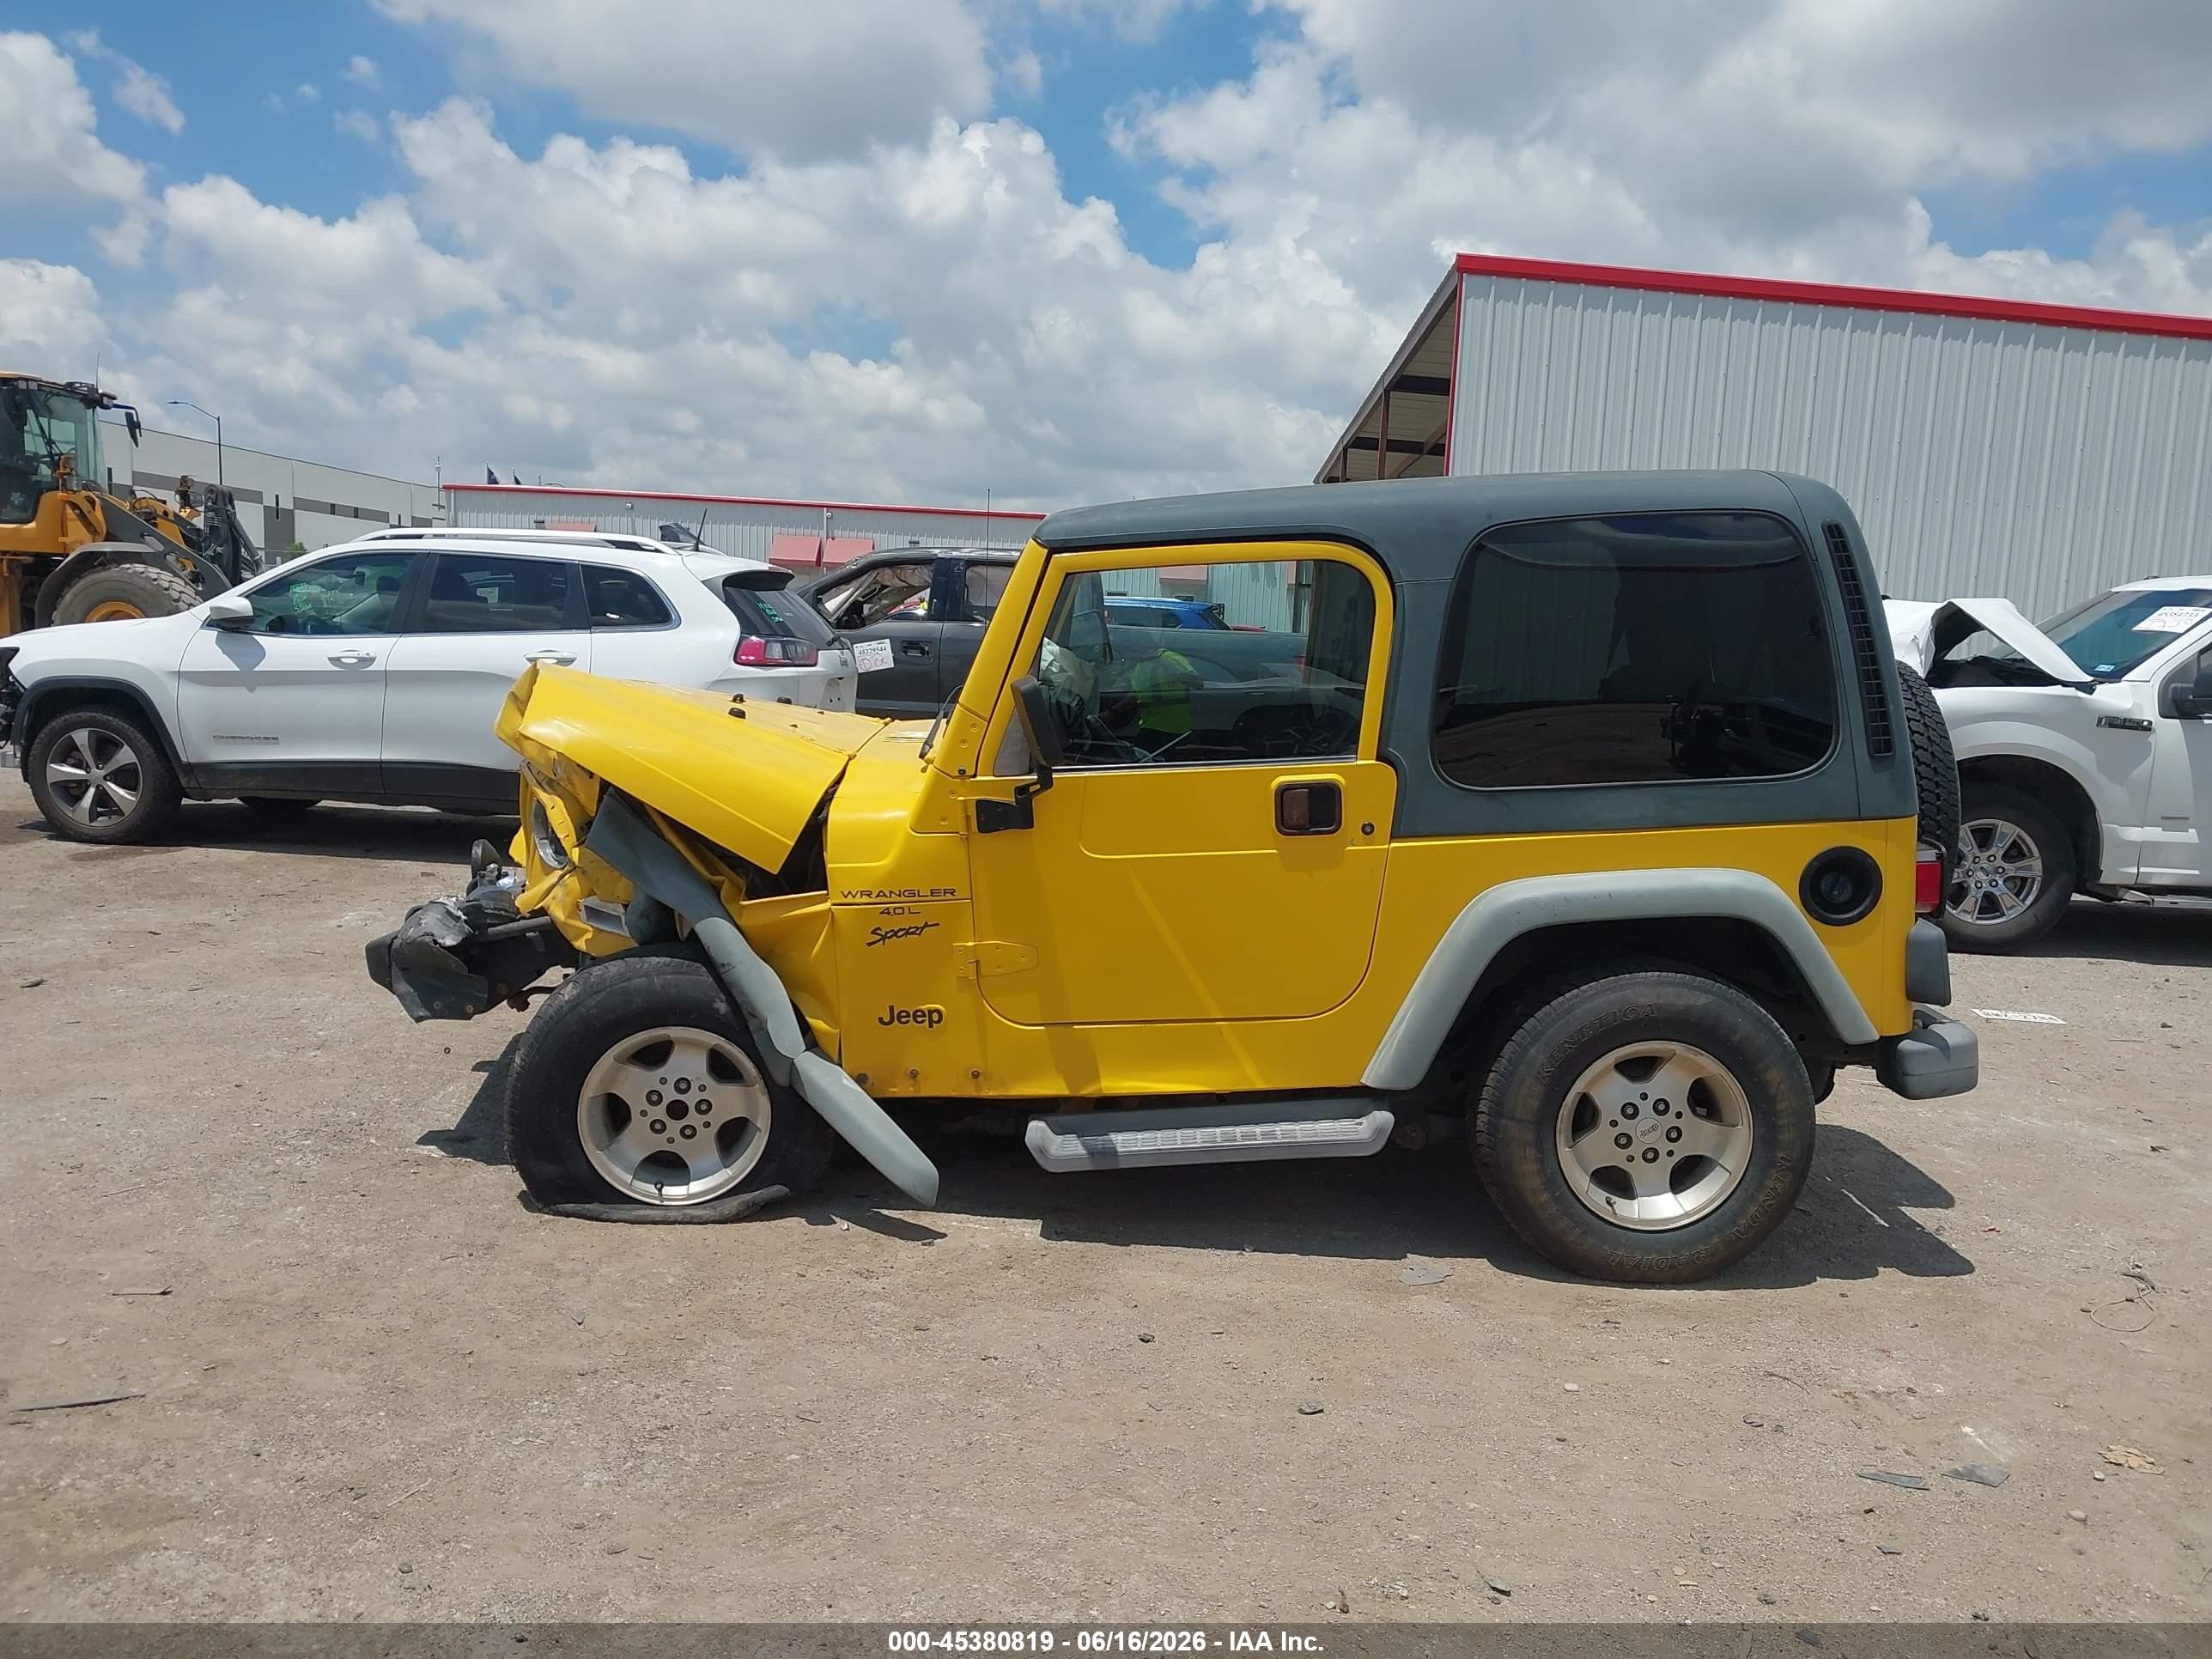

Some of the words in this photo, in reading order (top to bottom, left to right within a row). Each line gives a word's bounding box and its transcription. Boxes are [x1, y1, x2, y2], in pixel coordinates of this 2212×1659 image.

[840, 888, 957, 899] WRANGLER
[866, 920, 941, 947] Sport
[878, 1005, 944, 1029] Jeep
[1537, 1001, 1657, 1085] KENETICA
[1731, 1153, 1791, 1239] KENDA
[1607, 1245, 1711, 1272] RADIAL
